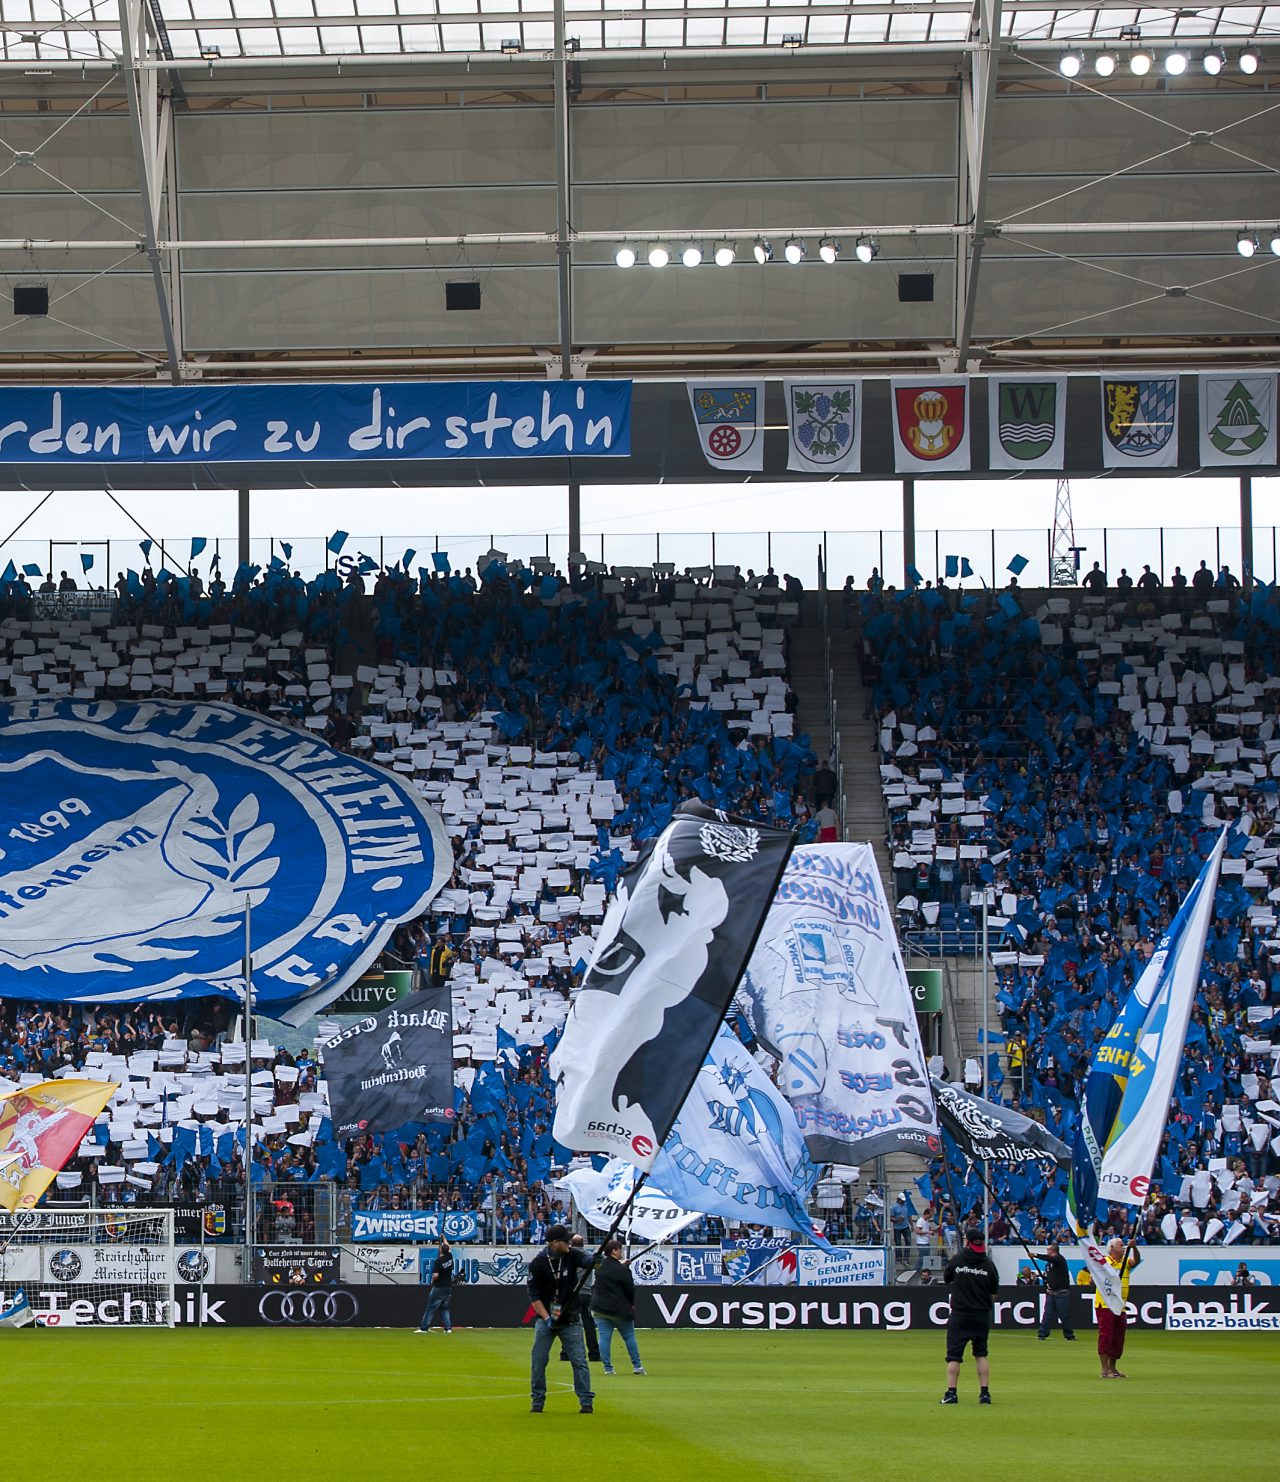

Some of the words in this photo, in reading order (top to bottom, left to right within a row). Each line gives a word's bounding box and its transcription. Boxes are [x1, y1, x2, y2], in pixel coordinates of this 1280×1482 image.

[147, 410, 237, 455] wir
[263, 420, 321, 453] zu
[349, 388, 430, 451] dir
[445, 386, 614, 451] steh'n
[8, 699, 425, 875] HOFFENHEIM
[8, 797, 92, 843] 1899
[44, 1212, 86, 1227] Jungs
[354, 1214, 439, 1237] ZWINGER
[451, 1220, 466, 1230] 01
[307, 1258, 334, 1267] Tigers
[356, 1247, 380, 1258] 1899
[817, 1259, 883, 1276] GENERATION
[807, 1271, 875, 1286] SUPPORTERS
[39, 1291, 227, 1324] Technik
[652, 1293, 912, 1331] Vorsprung
